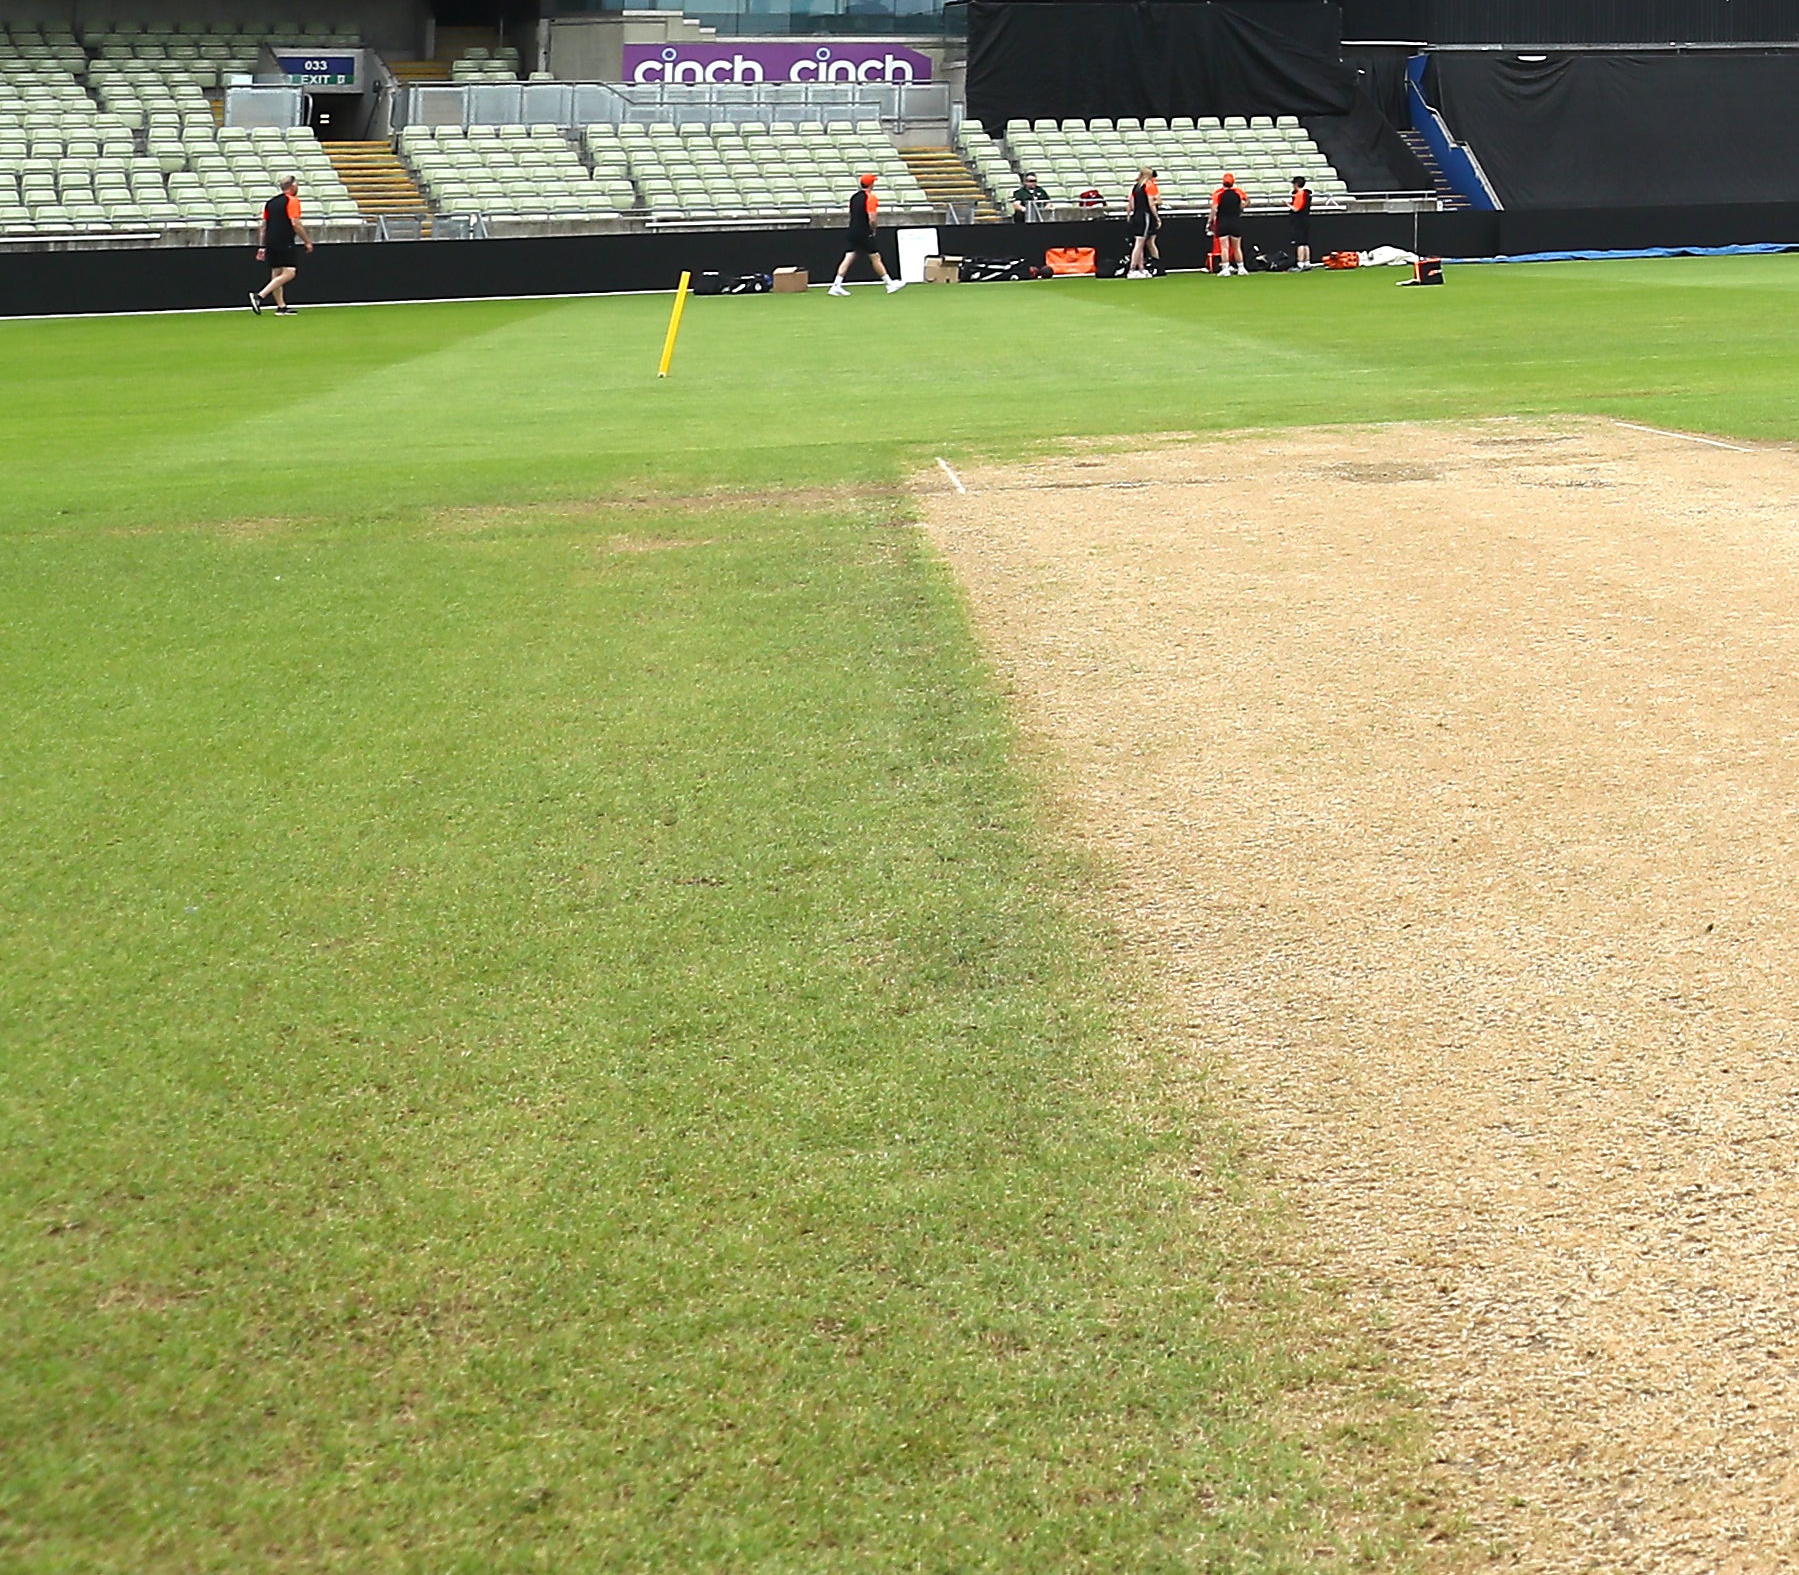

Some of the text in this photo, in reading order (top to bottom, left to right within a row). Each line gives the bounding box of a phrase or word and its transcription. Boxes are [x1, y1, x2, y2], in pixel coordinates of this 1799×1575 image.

[304, 61, 327, 71] 033
[634, 47, 763, 83] cinch
[790, 47, 913, 85] cinch
[301, 75, 331, 84] EXIT
